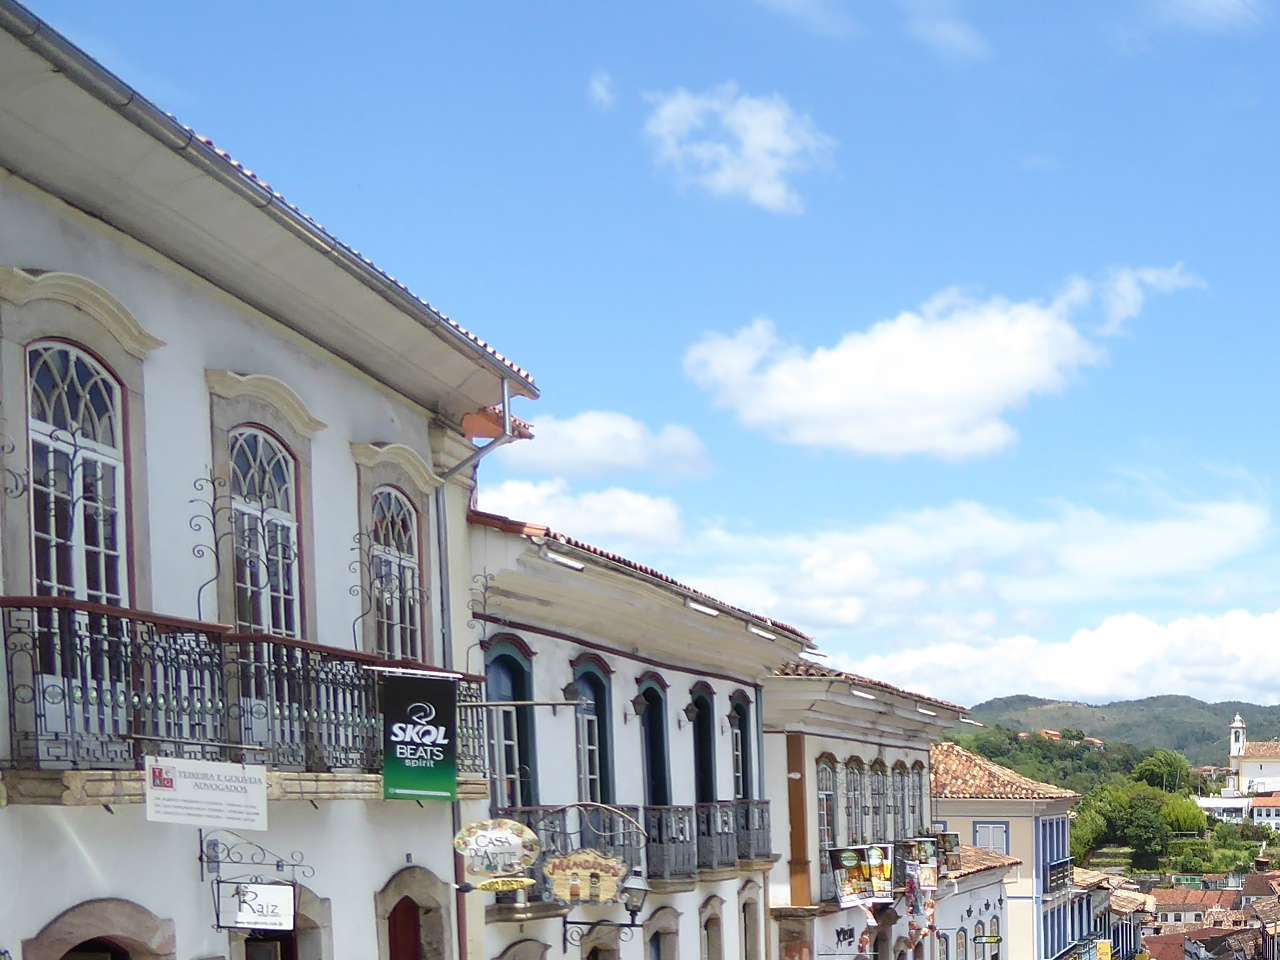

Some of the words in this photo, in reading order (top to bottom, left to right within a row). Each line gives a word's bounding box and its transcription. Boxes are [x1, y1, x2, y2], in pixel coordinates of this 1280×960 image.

[390, 722, 450, 745] SKOL
[396, 744, 444, 760] BEATS
[405, 758, 435, 768] spirit
[177, 770, 216, 781] TEIXEIRA
[224, 776, 263, 785] GOUVEIA
[193, 781, 249, 793] ADVOGADOS
[238, 889, 279, 914] Raiz
